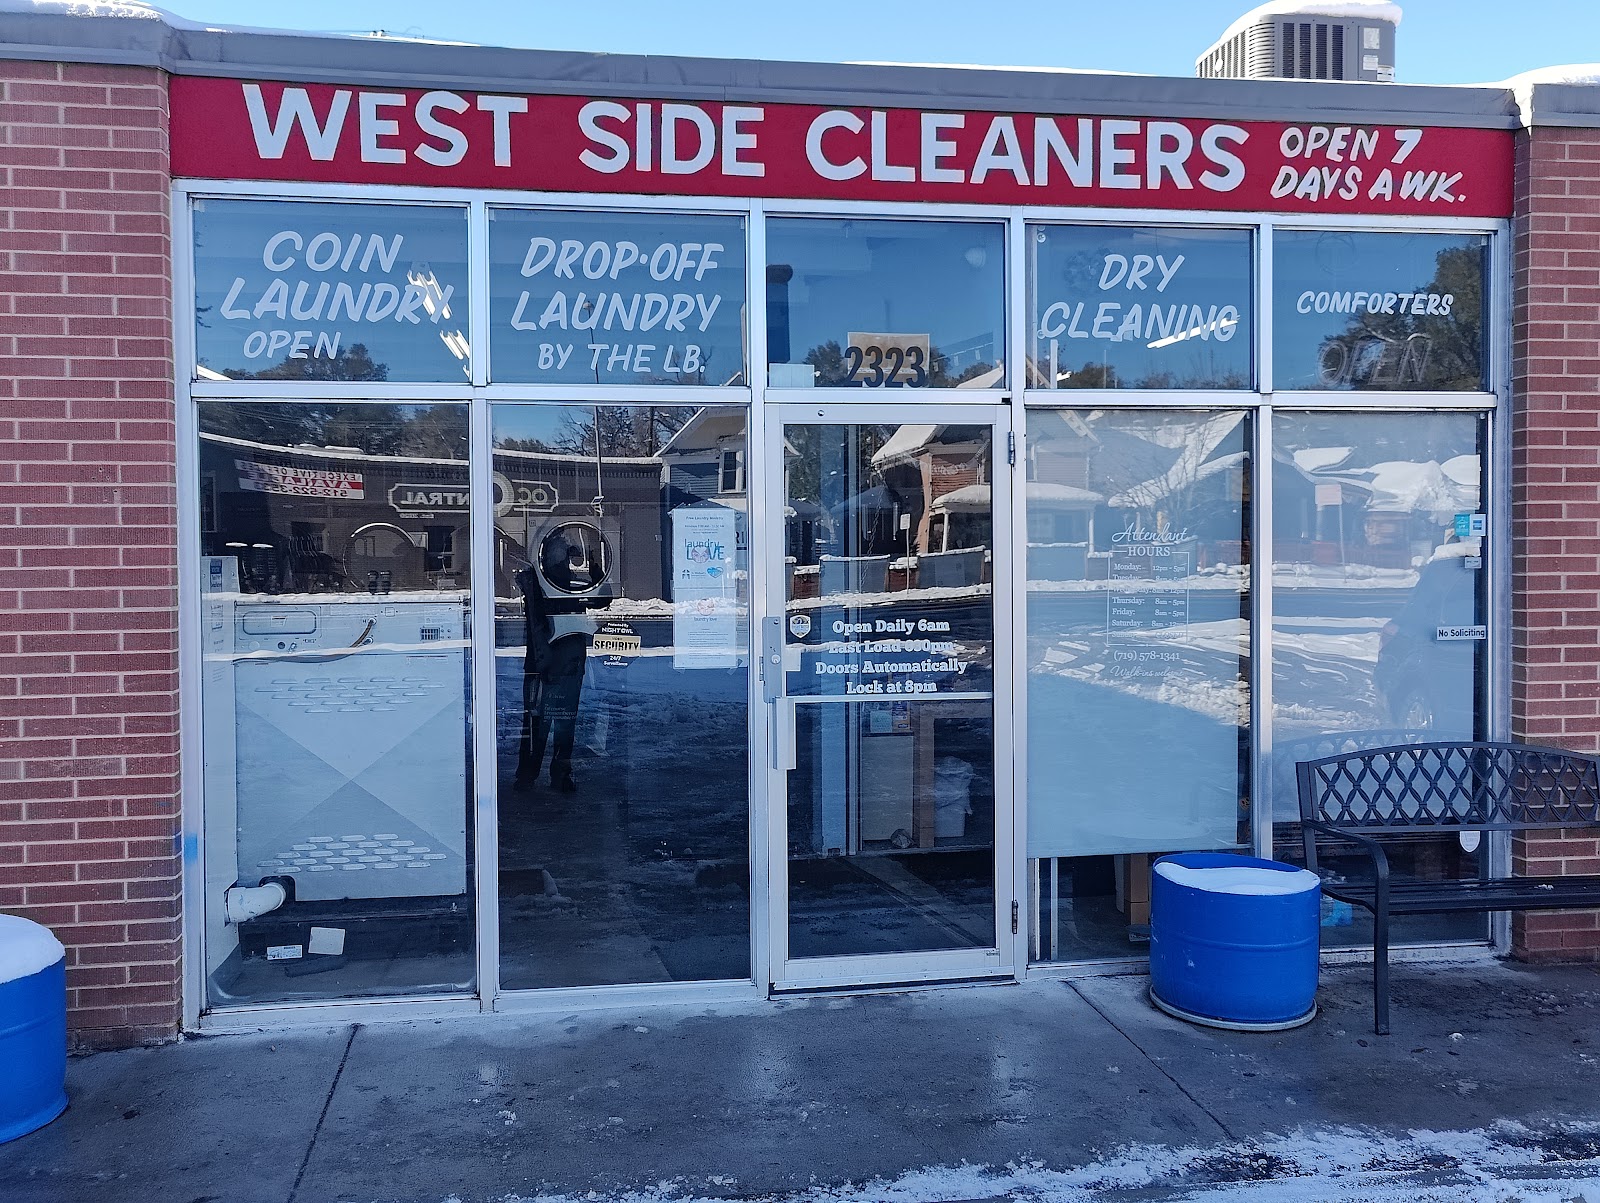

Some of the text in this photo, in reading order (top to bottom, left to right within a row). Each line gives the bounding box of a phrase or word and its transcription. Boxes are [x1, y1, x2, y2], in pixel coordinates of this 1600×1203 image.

[242, 83, 1250, 193] WEST SIDE CLEANERS
[1279, 126, 1423, 164] OPEN 7
[1270, 165, 1467, 203] DAYS A WK.
[262, 230, 404, 273] COIN
[1098, 254, 1186, 293] DRY
[220, 277, 455, 325] LAUNDRY
[510, 290, 722, 332] LAUNDRY
[1296, 290, 1454, 316] COMFORTERS
[1040, 301, 1239, 342] CLEANING
[243, 330, 342, 360] OPEN
[537, 343, 707, 373] BY THE LB.
[844, 345, 927, 388] 2323
[1316, 337, 1434, 388] OPEN
[1111, 521, 1188, 543] Attendant
[1127, 546, 1171, 557] HOURS
[1113, 563, 1142, 571] Monday:
[1112, 596, 1145, 605] Thursday:
[1155, 597, 1168, 605] 8am
[1112, 607, 1136, 616] Friday:
[832, 618, 951, 636] Open Daily 6am
[1112, 619, 1144, 627] Saturday:
[1438, 628, 1485, 638] No Soliciting
[594, 640, 640, 651] SECURITY
[828, 640, 861, 653] Last
[864, 640, 902, 653] Load
[1113, 649, 1180, 662] (719) 578-1341
[815, 658, 968, 675] Doors Automatically
[846, 680, 938, 694] Lock at 8pm
